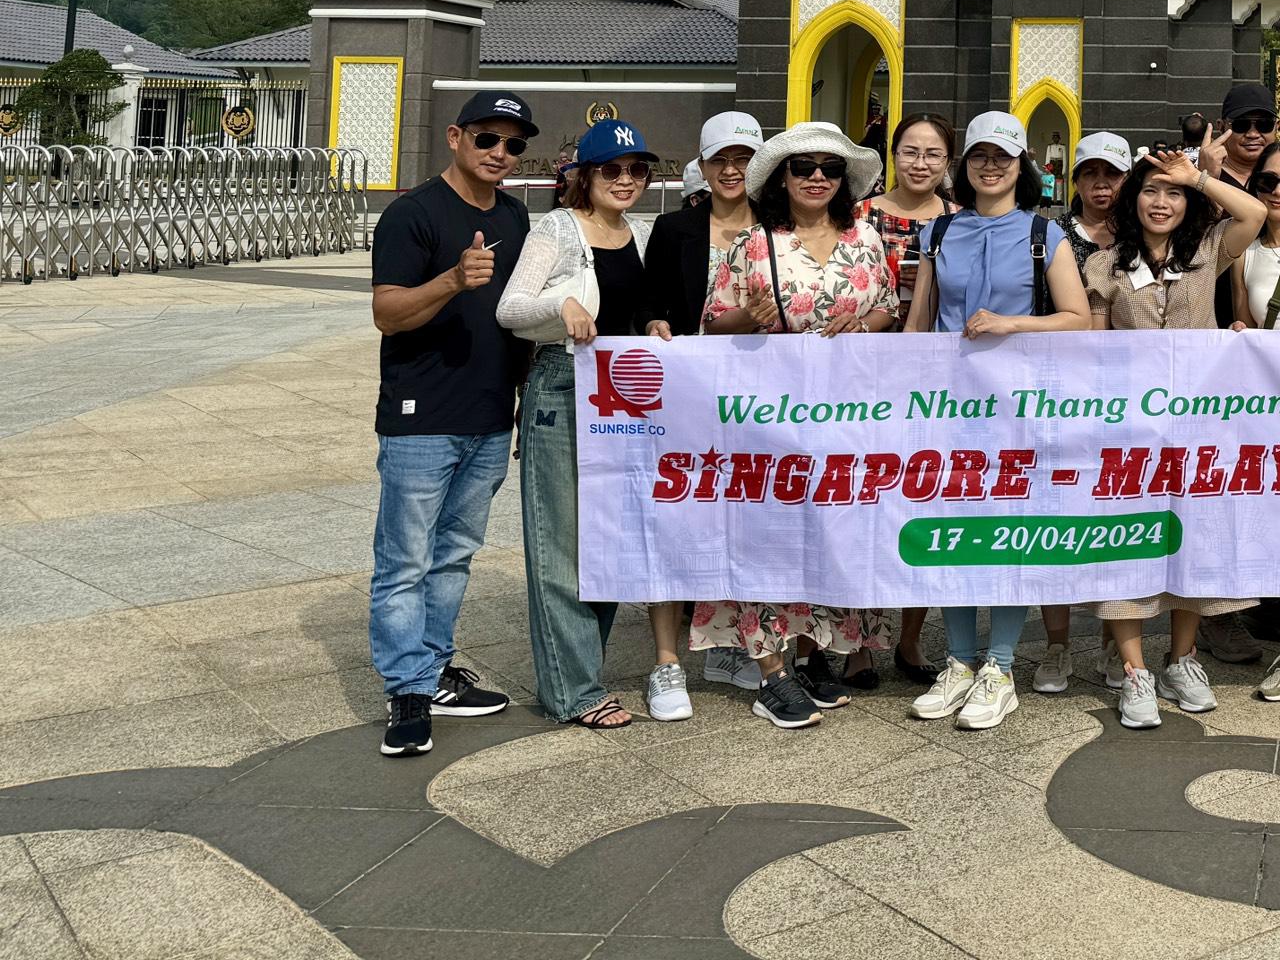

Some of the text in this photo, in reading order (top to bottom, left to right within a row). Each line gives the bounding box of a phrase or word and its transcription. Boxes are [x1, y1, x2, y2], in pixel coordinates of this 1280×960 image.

[717, 393, 892, 424] Welcome
[907, 390, 998, 419] Nhat
[1012, 389, 1128, 423] Thang
[589, 423, 666, 436] SUNRISE CO
[927, 528, 963, 552] 17
[993, 521, 1164, 554] 20/04/2024
